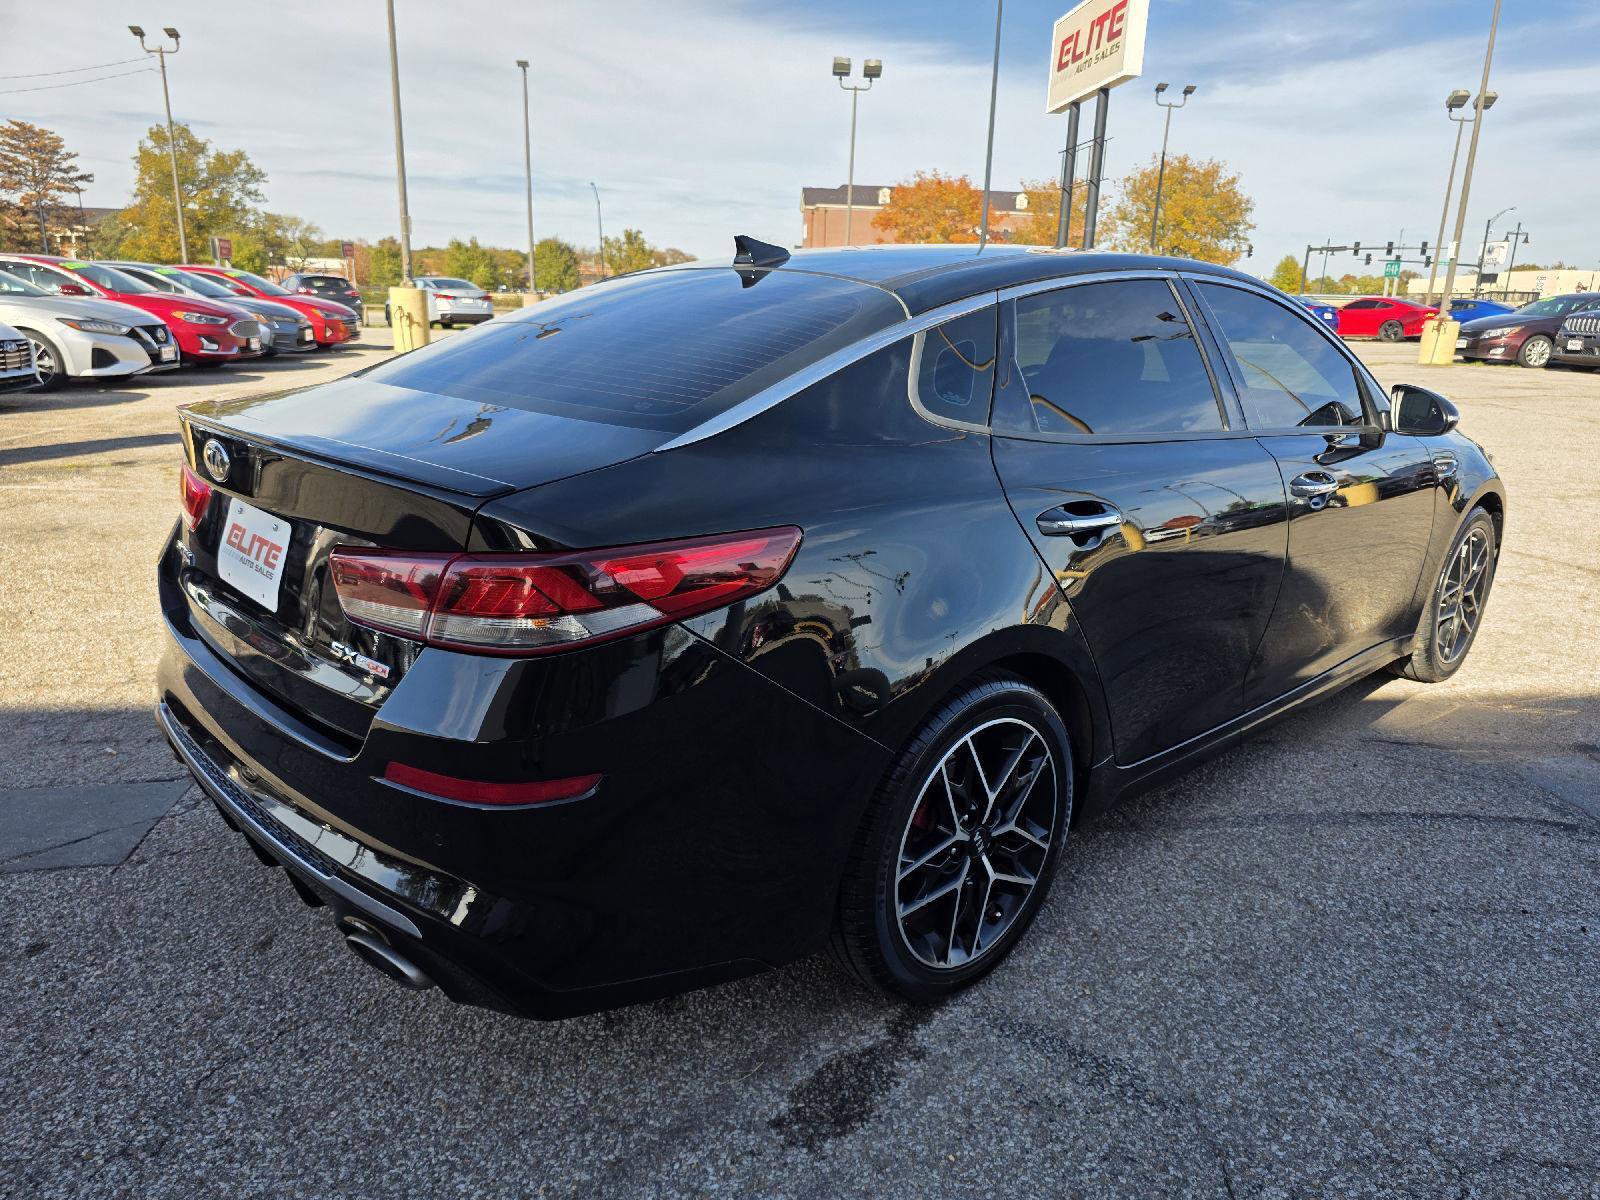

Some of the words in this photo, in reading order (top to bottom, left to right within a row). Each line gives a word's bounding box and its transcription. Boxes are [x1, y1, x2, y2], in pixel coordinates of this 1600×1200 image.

[1057, 0, 1128, 73] ELITE
[1074, 57, 1092, 75] AUTO
[1094, 42, 1120, 66] SALES
[226, 522, 283, 570] ELITE
[239, 556, 255, 570] AUTO
[255, 564, 275, 581] SALES
[330, 641, 358, 664] SX
